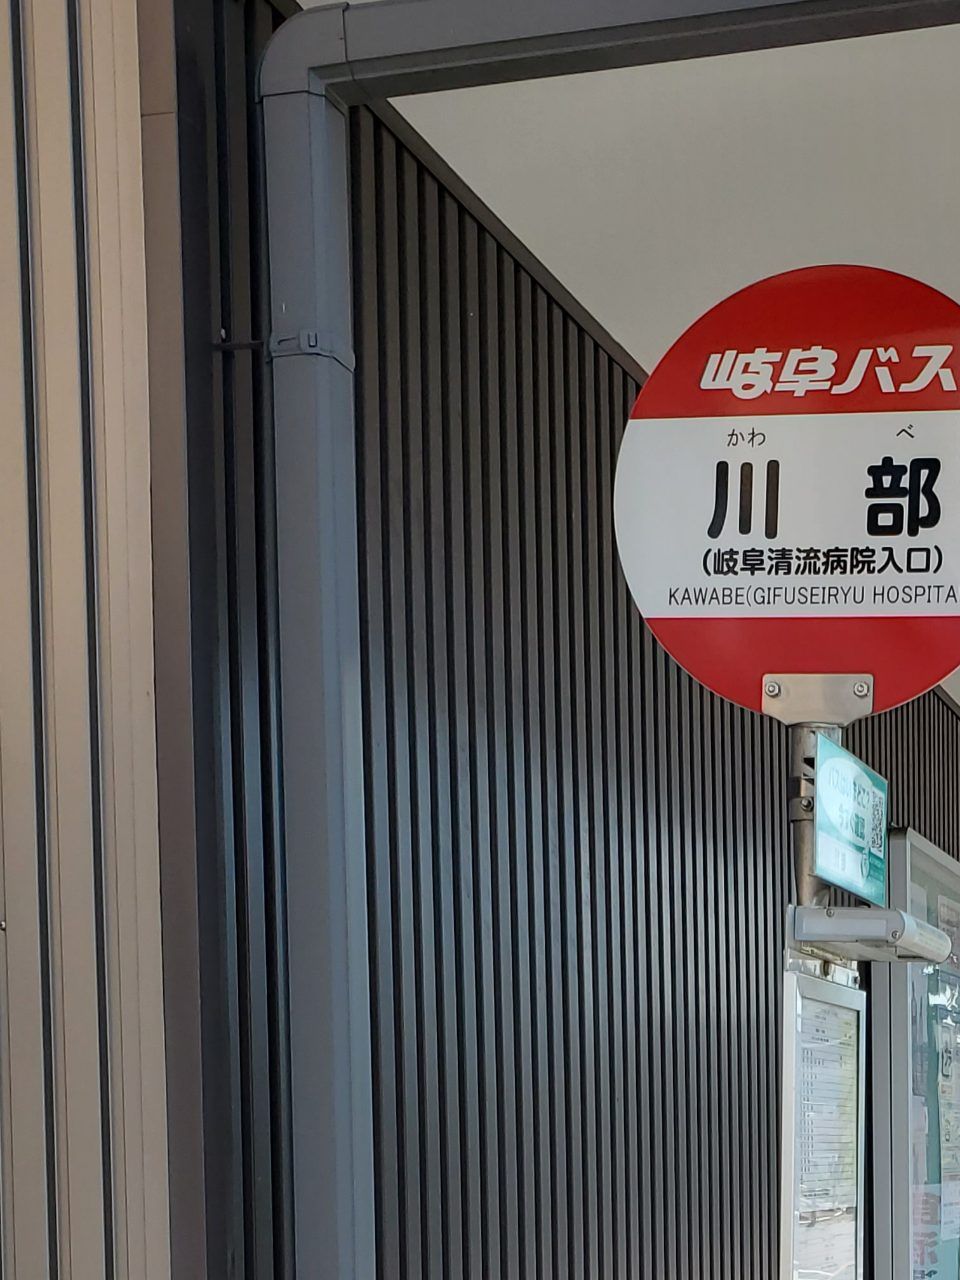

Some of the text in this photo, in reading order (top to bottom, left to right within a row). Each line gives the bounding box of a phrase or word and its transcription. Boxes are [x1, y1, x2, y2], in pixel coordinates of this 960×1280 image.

[700, 345, 957, 399] 岐阜バス
[727, 424, 915, 447] かわ べ
[702, 546, 943, 577] (岐阜清流病院入口)
[669, 586, 865, 607] KAWABE(GIFUSEIRYU
